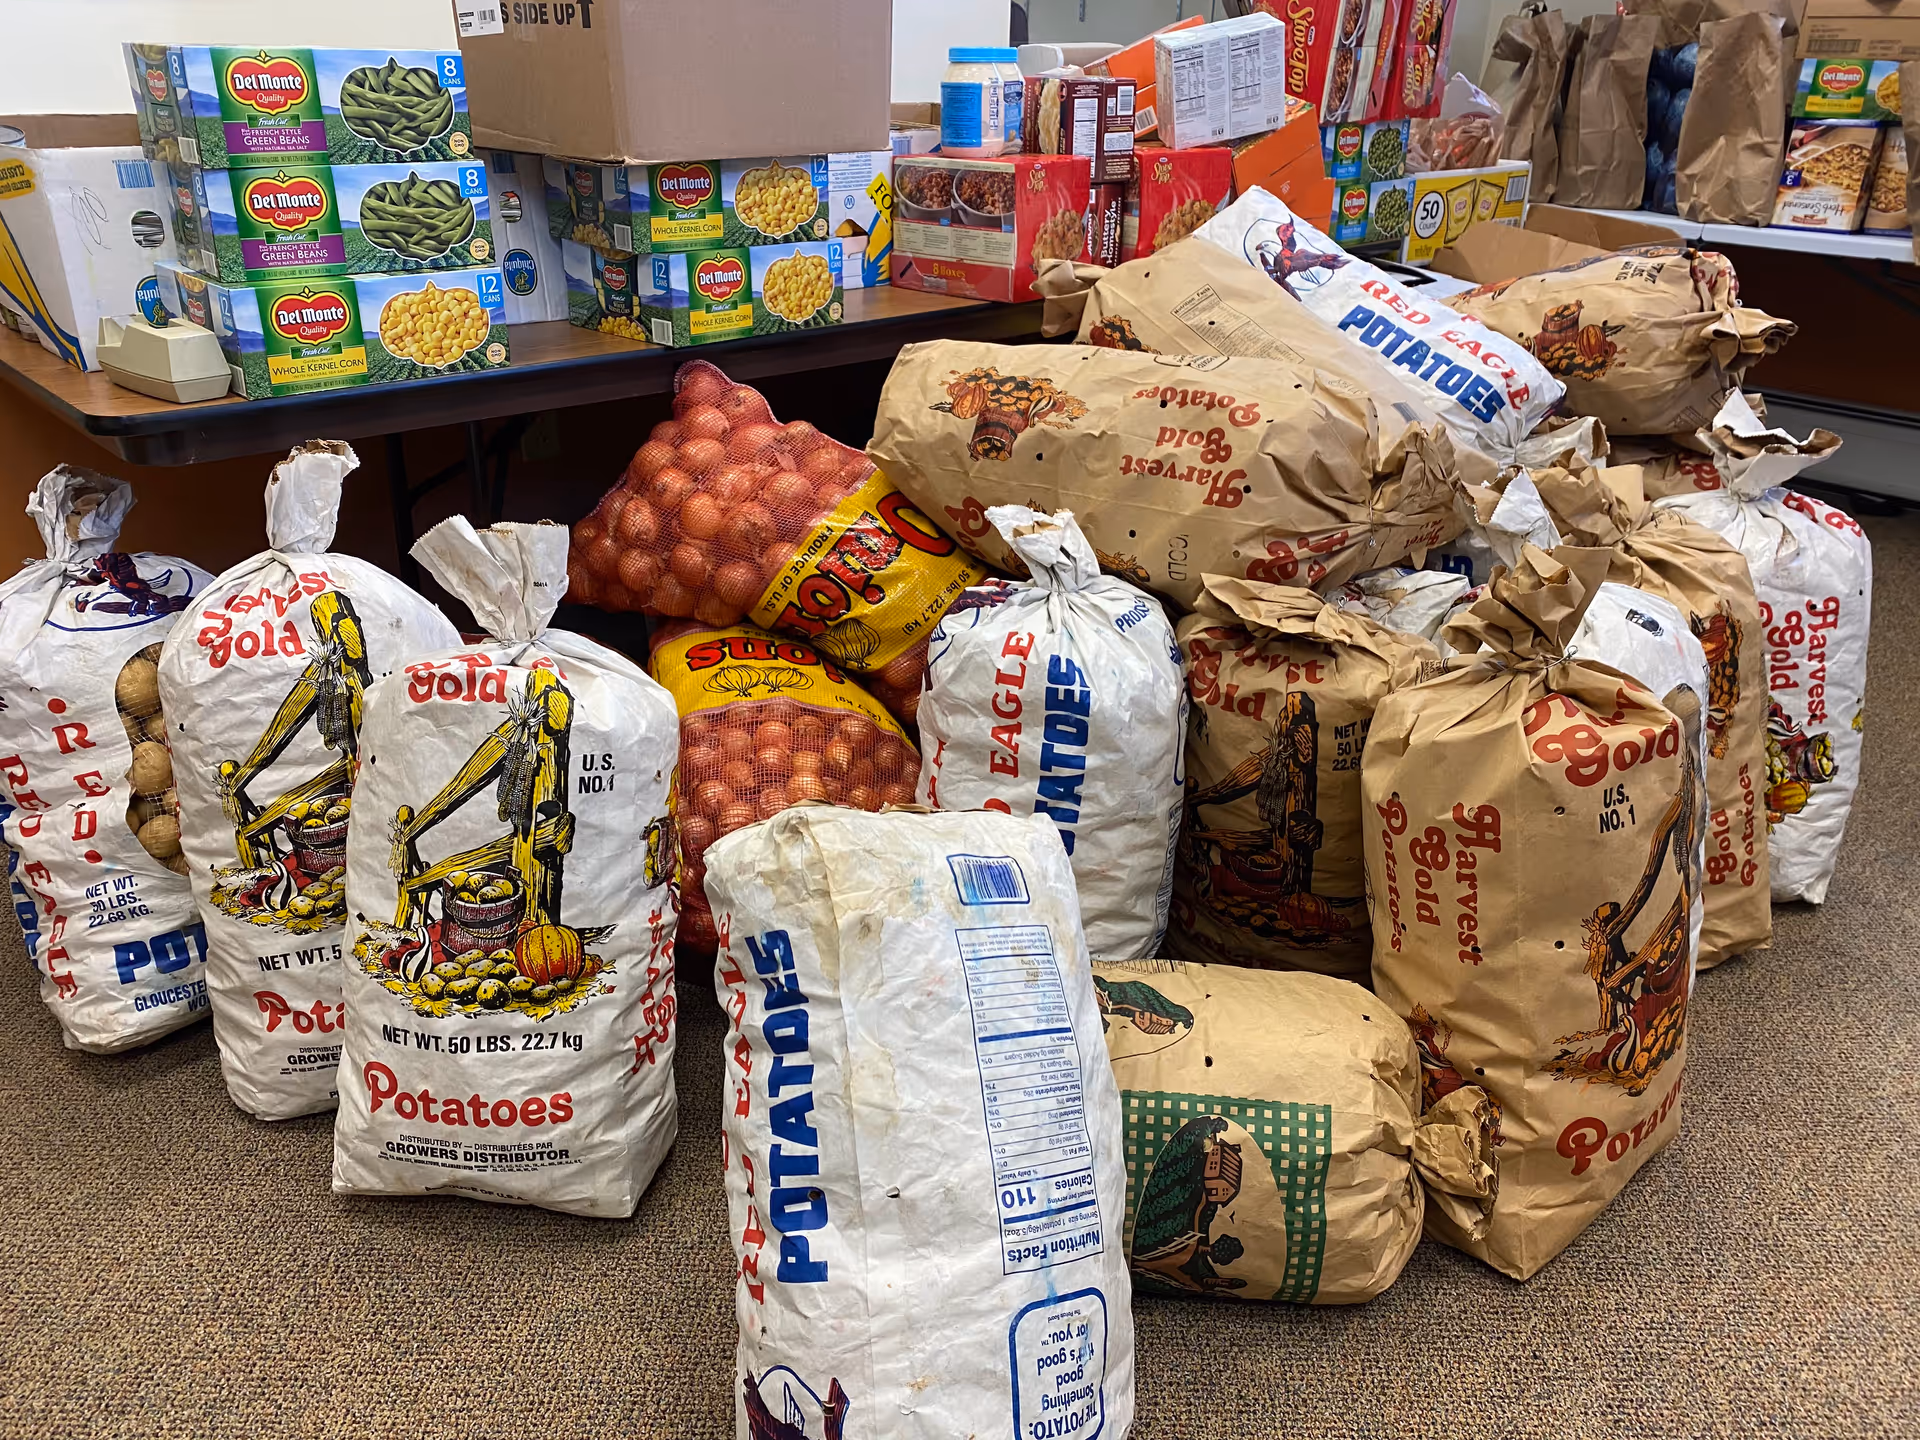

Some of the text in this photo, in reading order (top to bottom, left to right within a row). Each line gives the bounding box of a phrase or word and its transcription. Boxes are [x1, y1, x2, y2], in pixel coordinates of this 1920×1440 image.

[513, 2, 575, 25] SIDE UP
[1287, 0, 1315, 94] Stove Top
[172, 56, 180, 75] 8
[444, 58, 457, 77] 8
[233, 73, 302, 90] Del Monte
[256, 92, 285, 104] Quality
[244, 136, 310, 146] GREEN BEANS
[814, 158, 827, 174] 12
[195, 176, 202, 196] 8
[466, 169, 479, 187] 8
[662, 178, 710, 191] Del Monte
[1787, 176, 1795, 185] 3
[251, 193, 321, 209] Del Monte
[676, 192, 697, 201] Quality
[275, 211, 303, 222] Quality
[1421, 200, 1440, 220] 50
[1822, 204, 1845, 216] Herb
[654, 224, 722, 235] WHOLE KERNEL CORN
[1101, 210, 1111, 259] Buttery
[1107, 201, 1117, 264] Homestyle
[1419, 221, 1437, 231] Count
[262, 250, 328, 261] GREEN BEANS
[270, 244, 298, 252] FRENCH
[830, 246, 842, 260] 12
[656, 261, 667, 278] 12
[700, 270, 742, 285] Del Monte
[933, 263, 940, 275] 8
[482, 276, 500, 294] 12
[483, 294, 501, 303] CANS
[1174, 286, 1212, 315] Nutrition Facts
[221, 300, 231, 317] 12
[278, 308, 345, 326] Del Monte
[692, 315, 752, 328] WHOLE KERNEL CORN
[300, 326, 327, 336] Quality
[1360, 280, 1530, 411] RED EAGLE
[272, 358, 365, 376] WHOLE KERNEL CORN
[1337, 304, 1506, 424] POTATOES
[1132, 386, 1261, 428] Potatoes
[1119, 454, 1248, 509] Harvest
[777, 524, 834, 592] PRODUCE OF
[960, 569, 972, 583] 50
[902, 616, 923, 636] kg)
[1806, 596, 1841, 727] Harvest
[990, 631, 1036, 779] EAGLE
[1334, 724, 1358, 741] NET
[1034, 654, 1092, 857] TATOES
[1337, 742, 1352, 757] 50
[582, 754, 616, 772] U.S.
[52, 722, 111, 841] RED
[1603, 784, 1630, 808] U.S.
[1598, 806, 1637, 834] NO. 1
[1739, 761, 1759, 888] Potatoes
[1376, 797, 1409, 954] Potatoes
[1452, 802, 1503, 967] Harvest
[86, 875, 139, 899] NET WT.
[90, 891, 142, 913] 50 LBS.
[89, 904, 154, 928] 22.68 KG.
[24, 861, 79, 1000] EAGLE
[258, 946, 331, 972] NET WT.
[382, 1024, 583, 1054] NET WT. 50 LBS. 22.7 kg
[1056, 1035, 1074, 1043] Protein
[287, 1052, 343, 1066] GROWE
[1004, 1051, 1041, 1062] Added Sugars
[363, 1060, 574, 1128] Potatoes
[1034, 1085, 1069, 1096] Carbohydrate
[744, 929, 830, 1284] POTATOES
[400, 1134, 553, 1152] DISTRIBUTED BY DISTRIBUTÉES PAR
[386, 1141, 570, 1165] GROWERS DISTRIBUTOR
[1017, 1170, 1032, 1178] Daily
[1001, 1173, 1092, 1209] Calories 110
[1047, 1189, 1094, 1205] Amount per serving
[1068, 1216, 1078, 1224] size
[1078, 1210, 1098, 1220] Serving
[1007, 1230, 1100, 1263] Nutrition Facts
[1076, 1323, 1088, 1341] for
[1036, 1348, 1067, 1376] good
[1056, 1364, 1084, 1393] good
[1041, 1382, 1094, 1413] Something
[1028, 1408, 1084, 1440] POTATO:
